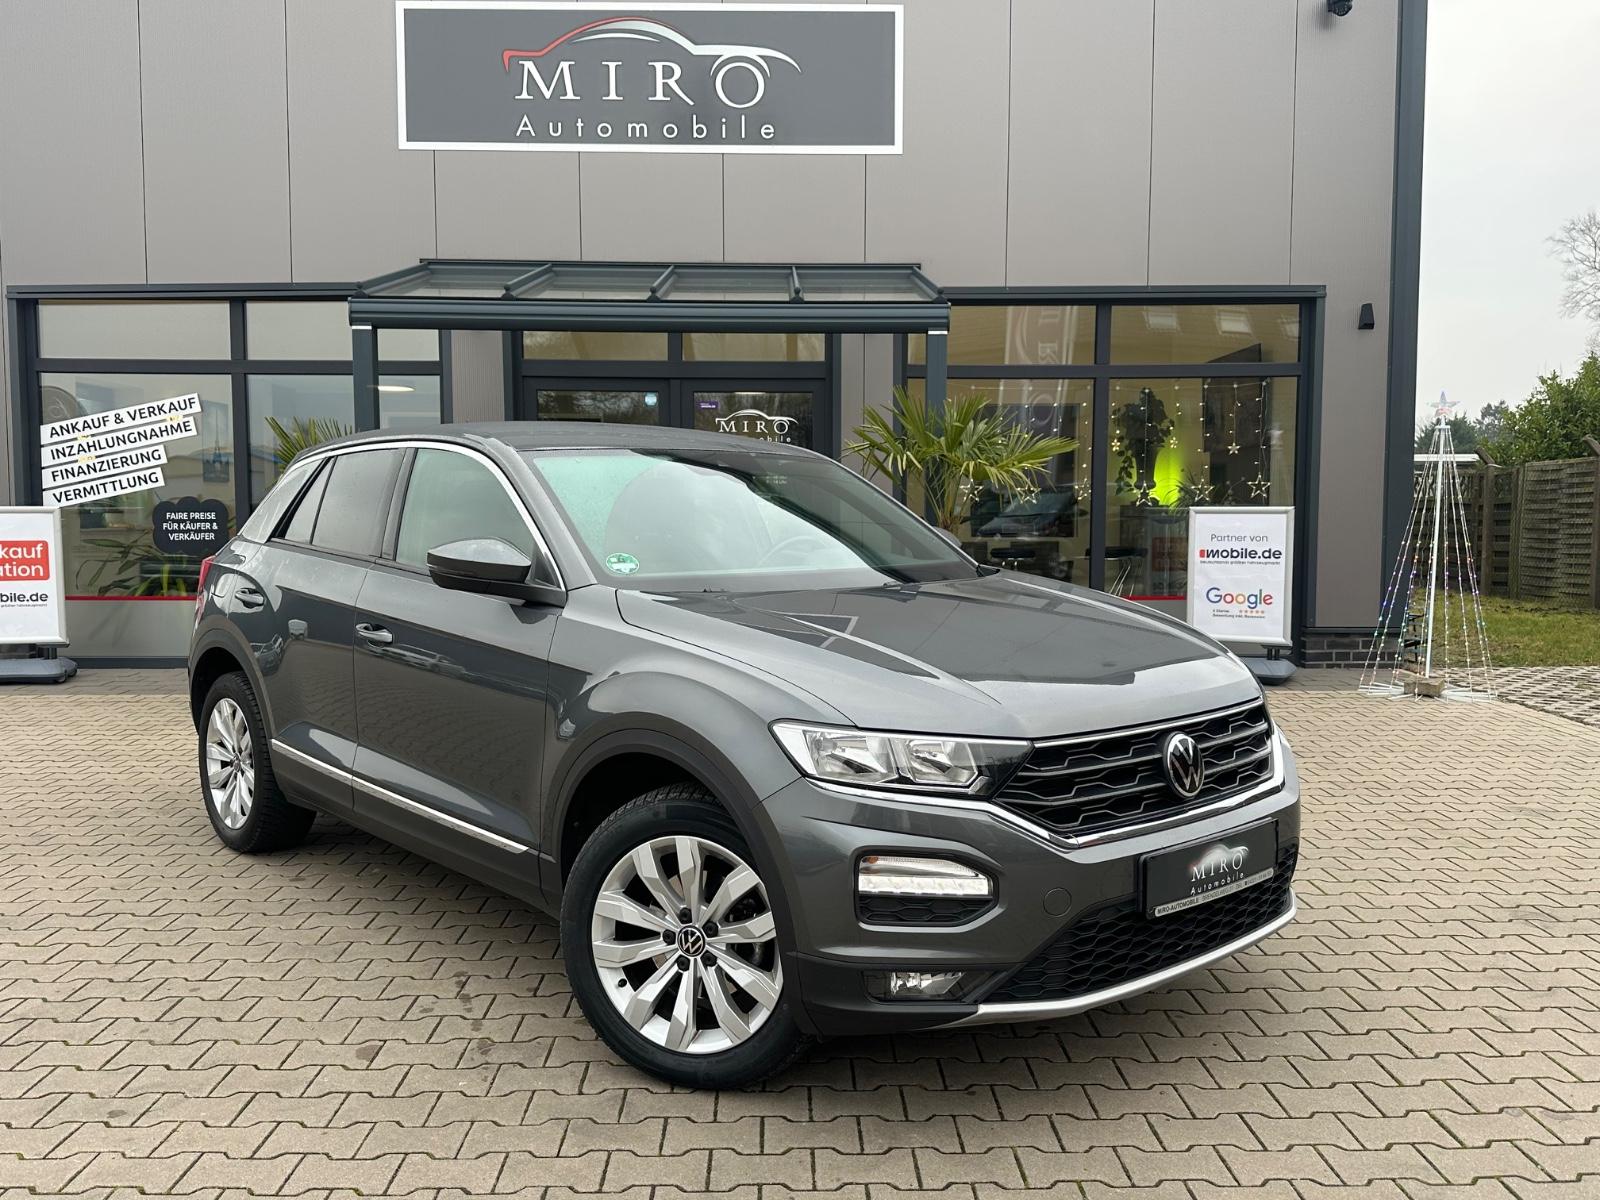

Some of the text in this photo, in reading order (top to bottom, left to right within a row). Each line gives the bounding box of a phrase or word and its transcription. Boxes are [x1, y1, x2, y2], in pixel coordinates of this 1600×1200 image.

[514, 60, 766, 109] MIRO
[515, 114, 776, 139] Automobile
[50, 397, 197, 438] ANKAUF & VERKAUF
[719, 421, 788, 434] MIRO
[50, 420, 193, 460] INZAHLUNGNAHME
[51, 449, 162, 482] FINANZIERUNG
[52, 472, 160, 503] VERMITTLUNG
[162, 521, 219, 530] FÜR KÄUFER &
[166, 512, 217, 520] FAIRE PREISE
[168, 531, 216, 541] VERKÄUFER
[1210, 533, 1268, 542] Partner von
[1206, 548, 1282, 559] mobile.de
[1206, 587, 1273, 609] Google
[1190, 853, 1243, 882] MIRO
[1190, 871, 1244, 896] Automobile
